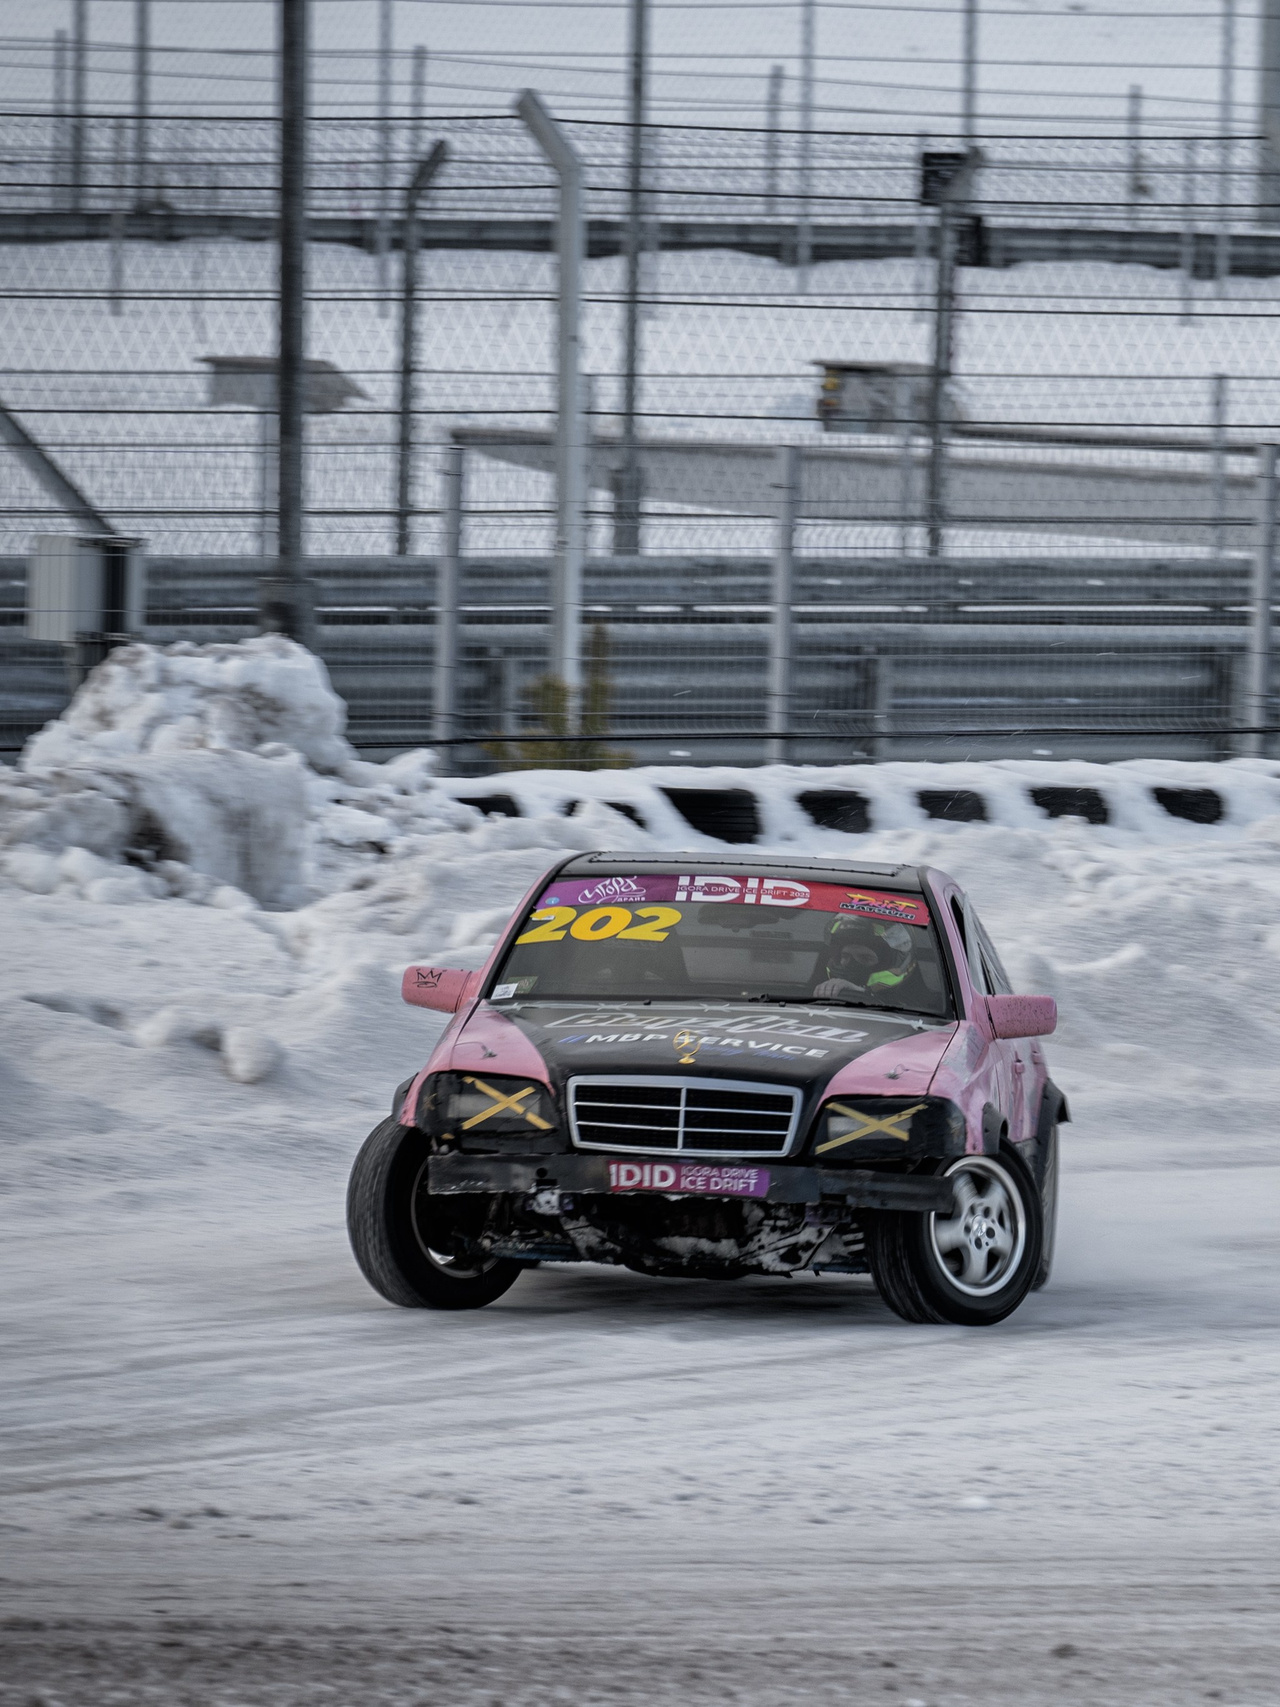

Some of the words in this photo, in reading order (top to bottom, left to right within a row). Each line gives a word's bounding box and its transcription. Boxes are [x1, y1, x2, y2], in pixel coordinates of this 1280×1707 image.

[675, 875, 810, 907] IDID
[711, 886, 740, 894] DRIVE
[760, 888, 788, 896] DRIFT
[789, 890, 811, 899] 2025
[515, 906, 682, 945] 202
[585, 1033, 668, 1044] MBP
[676, 1035, 830, 1058] SERVICE
[608, 1164, 676, 1188] IDID
[681, 1165, 719, 1178] IGORA
[721, 1167, 758, 1180] DRIVE
[680, 1177, 707, 1190] ICE
[710, 1178, 758, 1193] DRIFT
